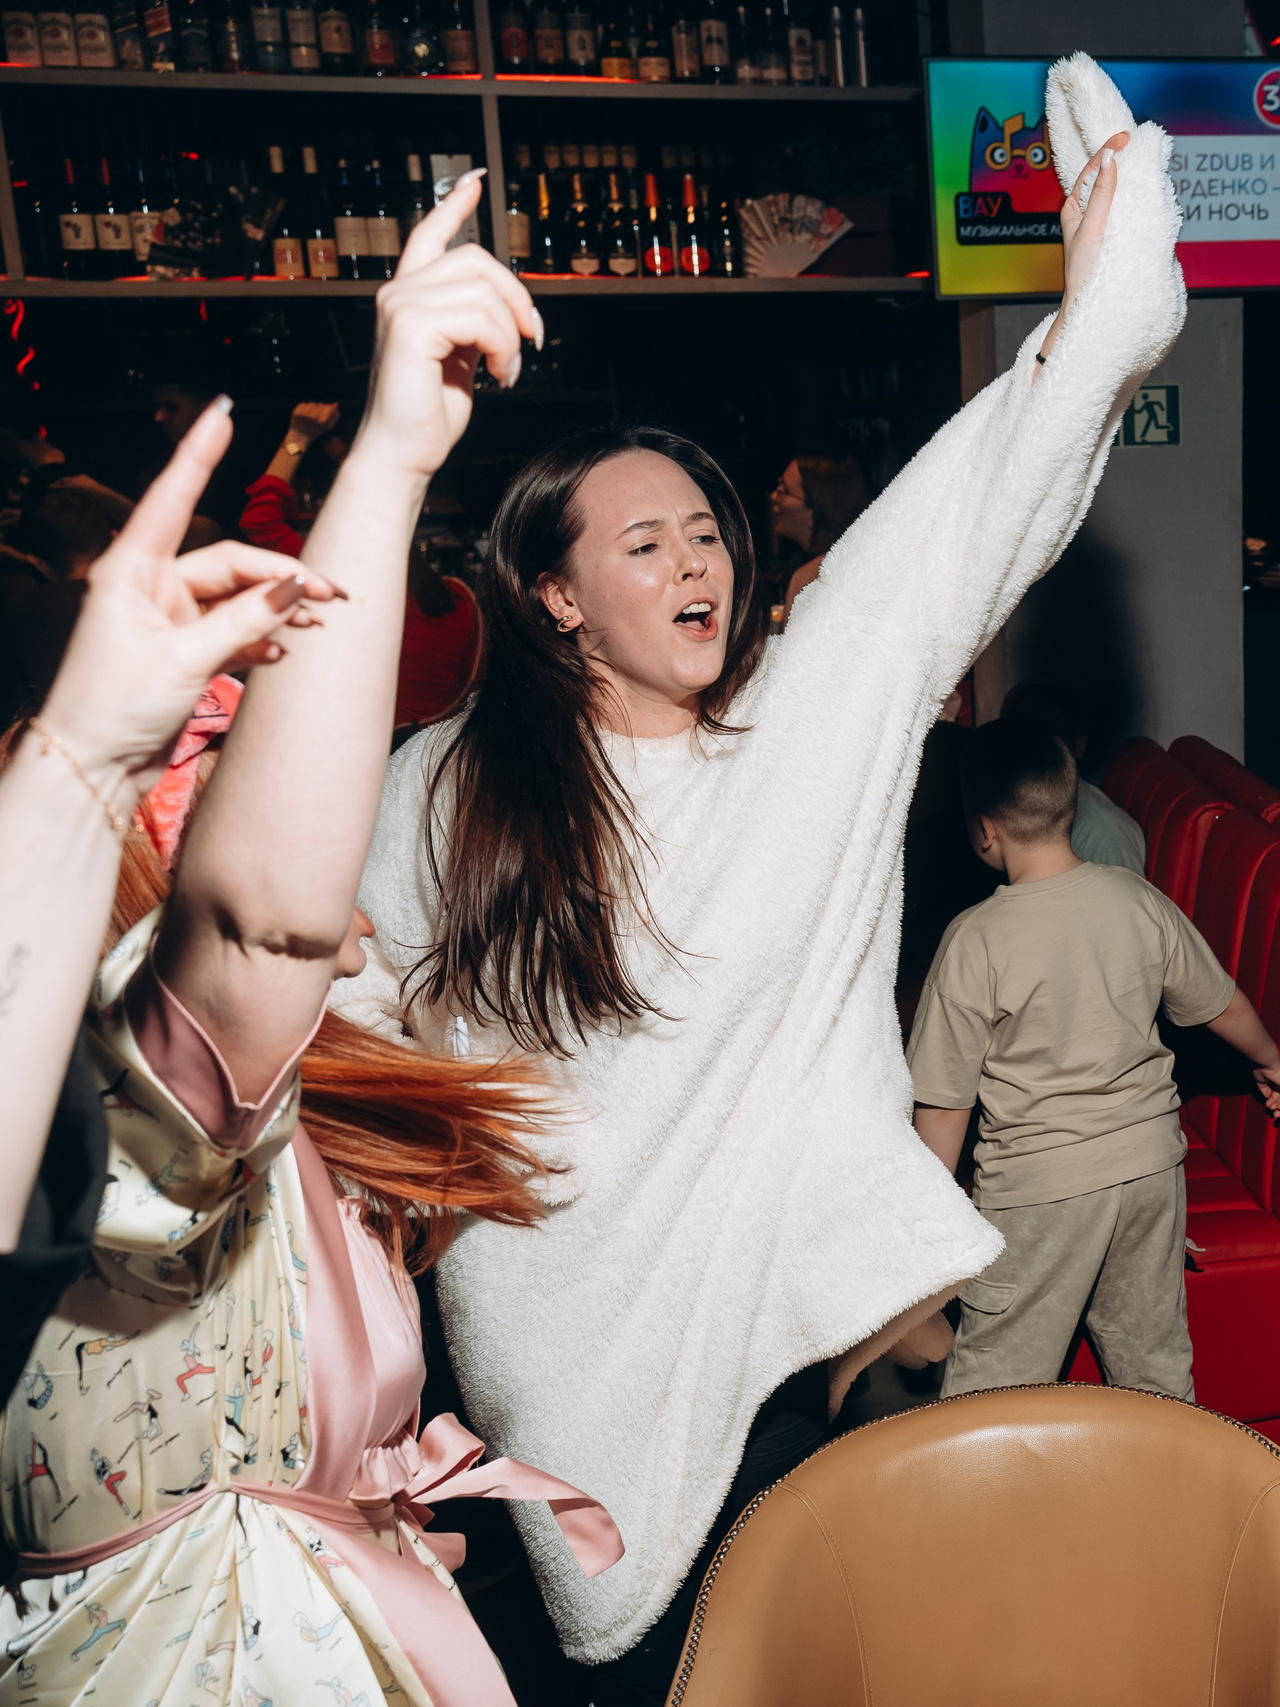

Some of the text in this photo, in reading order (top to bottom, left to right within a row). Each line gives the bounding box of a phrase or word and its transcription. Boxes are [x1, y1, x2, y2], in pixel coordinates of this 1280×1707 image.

[1195, 153, 1254, 172] ZDUB
[1260, 153, 1275, 171] И
[959, 195, 1003, 219] ВАУ
[1208, 202, 1270, 221] НОЧЬ
